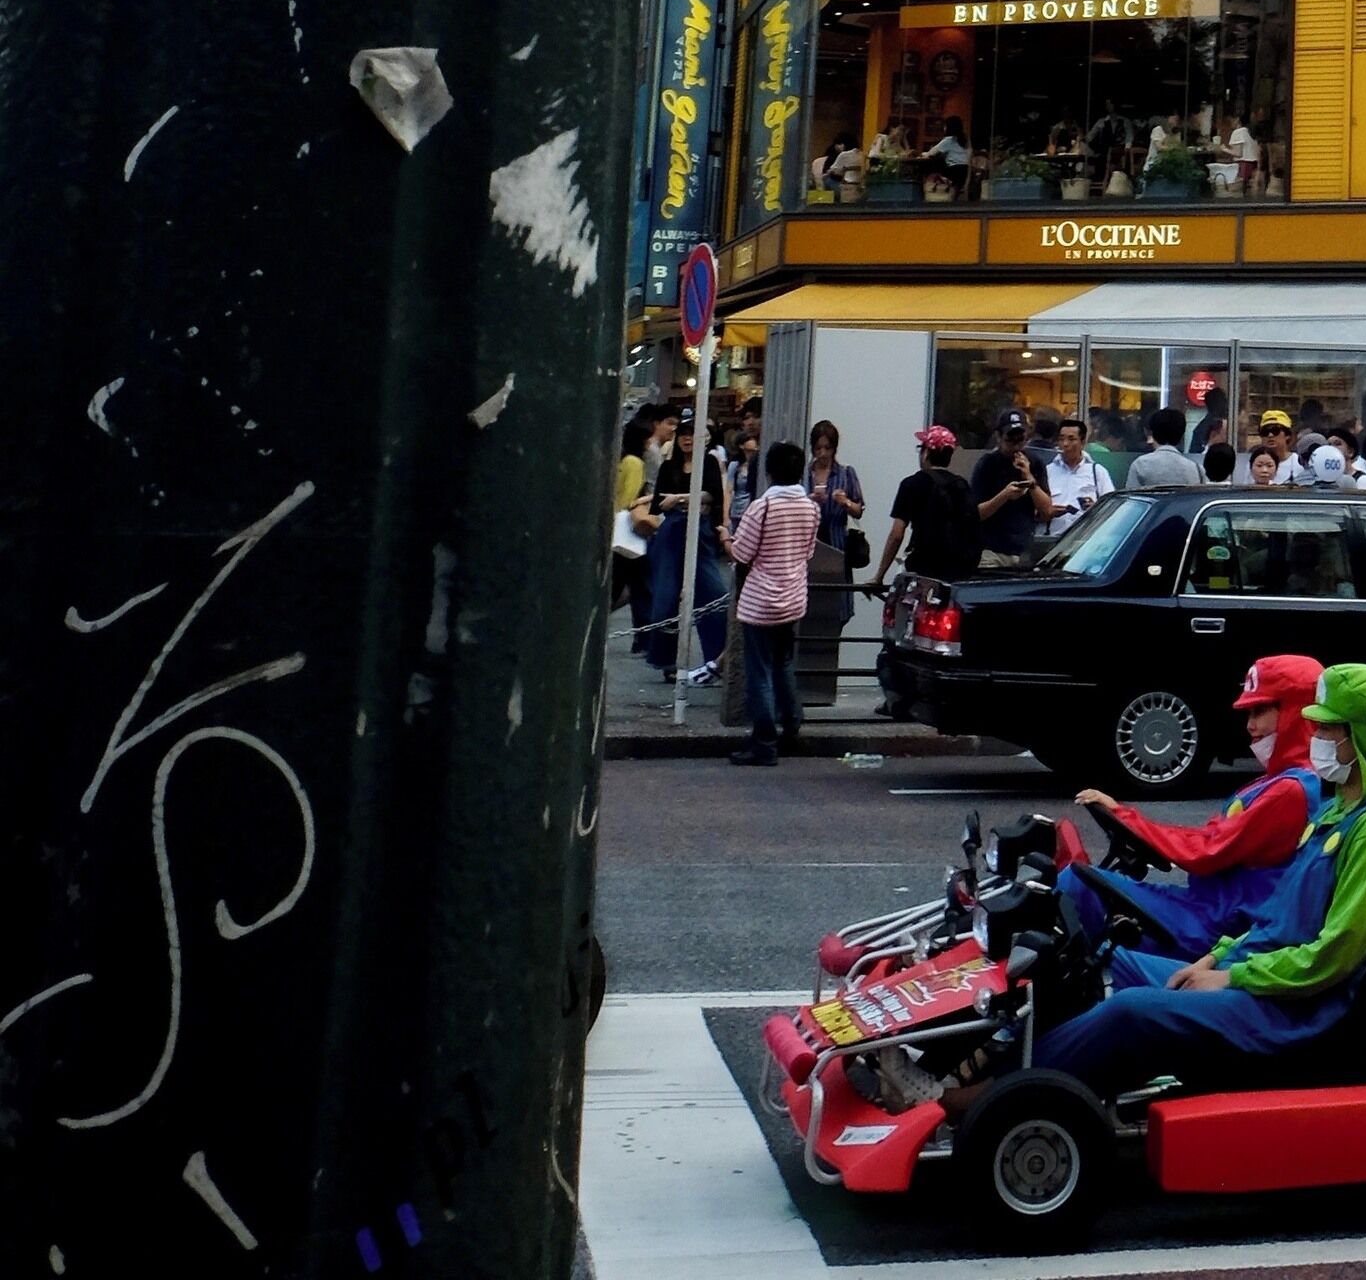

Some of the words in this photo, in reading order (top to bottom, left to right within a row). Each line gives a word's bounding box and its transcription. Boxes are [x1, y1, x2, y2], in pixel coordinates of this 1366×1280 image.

[953, 2, 988, 23] EN
[661, 89, 698, 219] Garden
[1040, 219, 1182, 247] L'OCCITANE
[1064, 249, 1082, 260] EN
[1086, 248, 1155, 260] PROVENCE
[1324, 458, 1341, 470] 600
